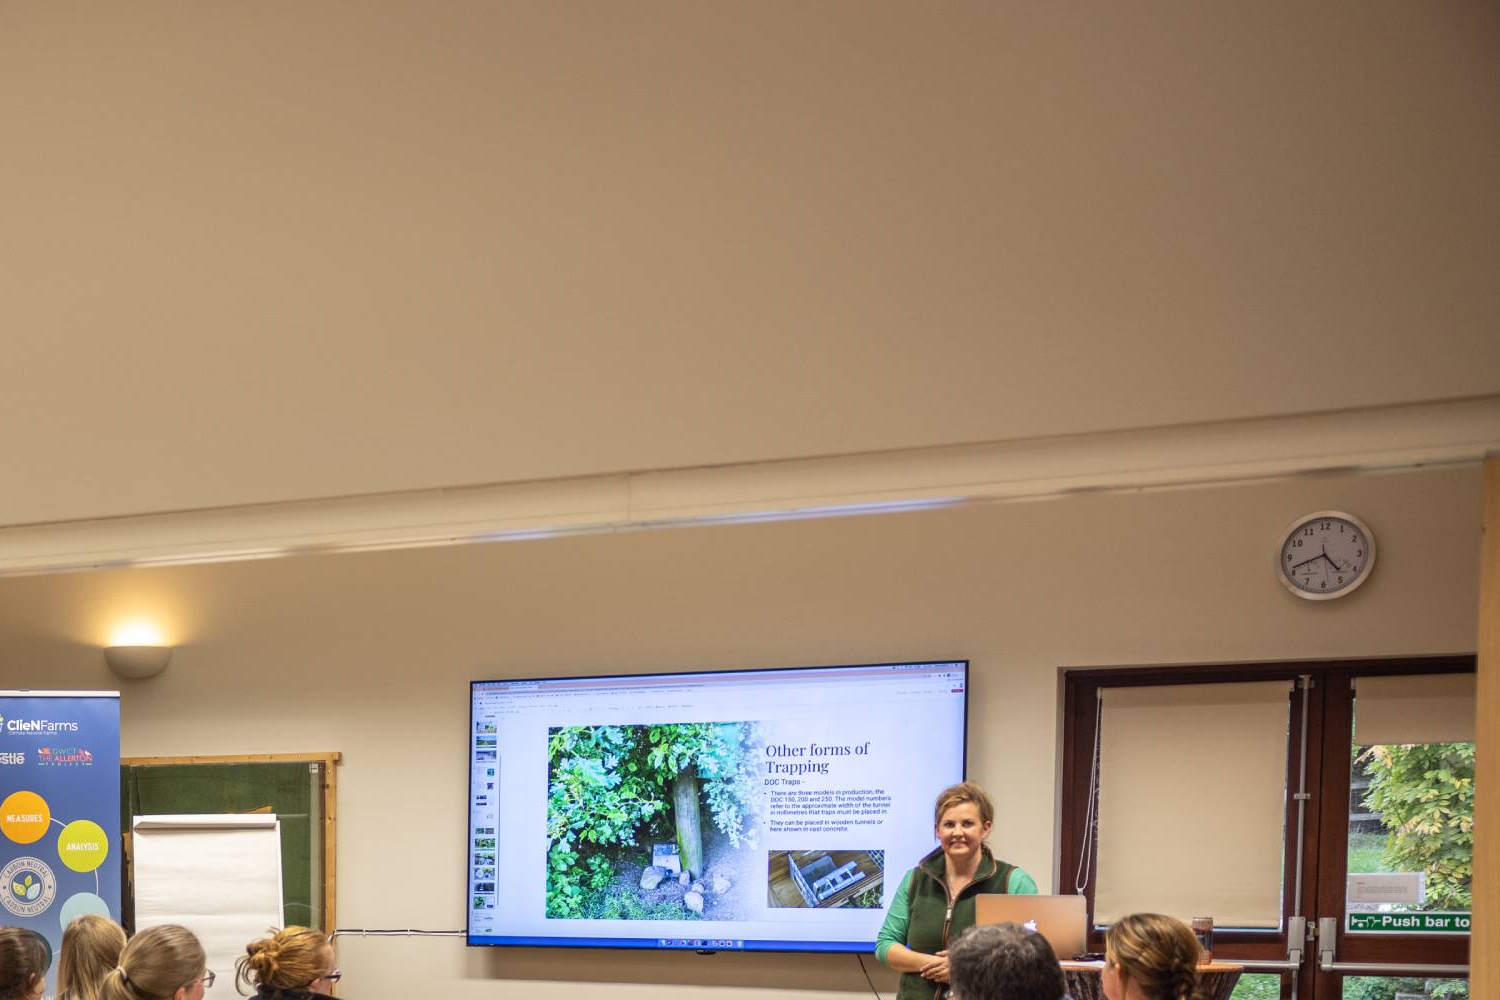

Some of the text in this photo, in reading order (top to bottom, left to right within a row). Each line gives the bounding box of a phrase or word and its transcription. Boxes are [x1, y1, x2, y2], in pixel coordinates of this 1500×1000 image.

[7, 719, 78, 731] ClieNFarms
[766, 742, 871, 757] Other forms of
[765, 760, 830, 775] Trapping
[7, 814, 43, 823] MEASURES
[66, 843, 99, 851] ANALYSIS
[4, 861, 49, 879] CARBON NEUTRAL
[4, 896, 50, 913] CARBON NEUTRAL
[1382, 916, 1470, 927] Push bar to
